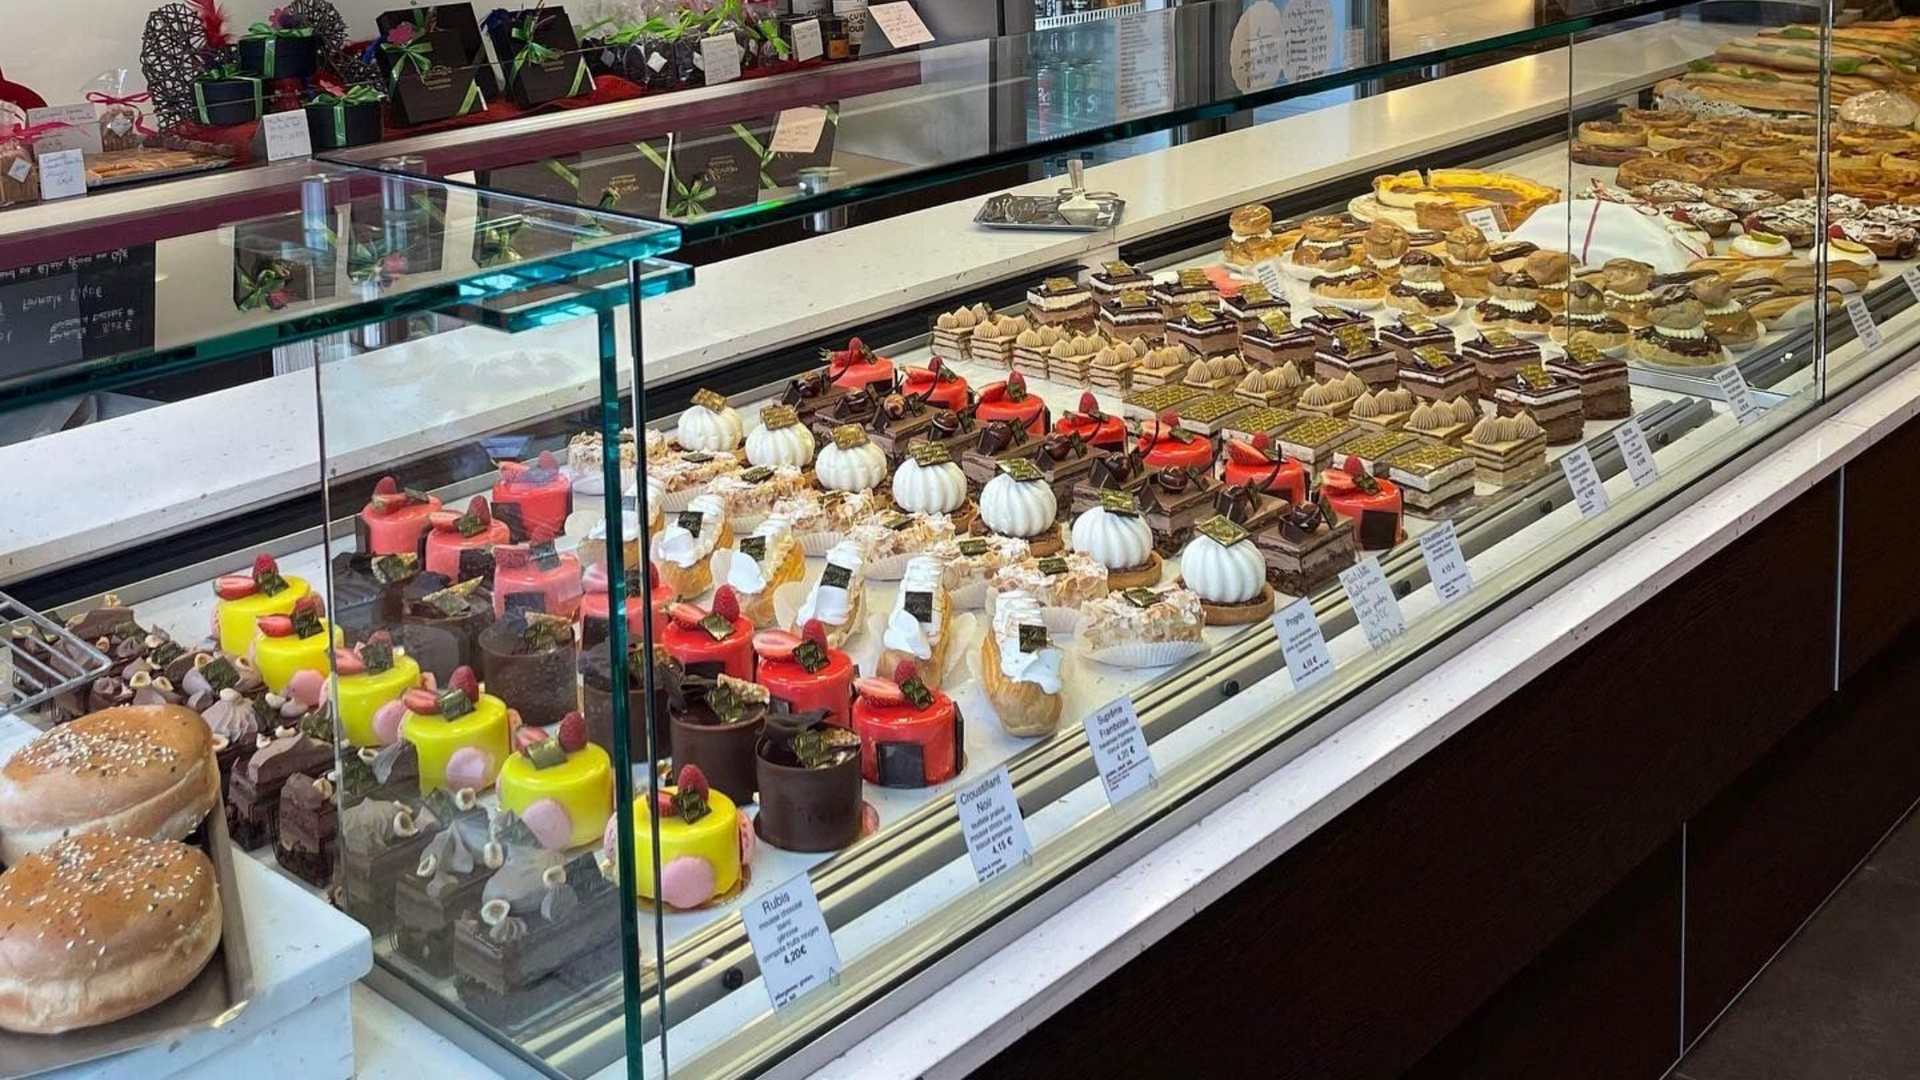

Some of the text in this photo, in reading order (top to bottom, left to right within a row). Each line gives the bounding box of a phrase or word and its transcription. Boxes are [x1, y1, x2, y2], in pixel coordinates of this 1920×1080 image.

[1099, 717, 1130, 739] Framboise
[960, 774, 1002, 805] Croustillant
[976, 797, 993, 814] Noir
[992, 836, 1013, 855] 4,15 €
[762, 891, 790, 915] Rubis
[784, 944, 808, 965] 4,20€
